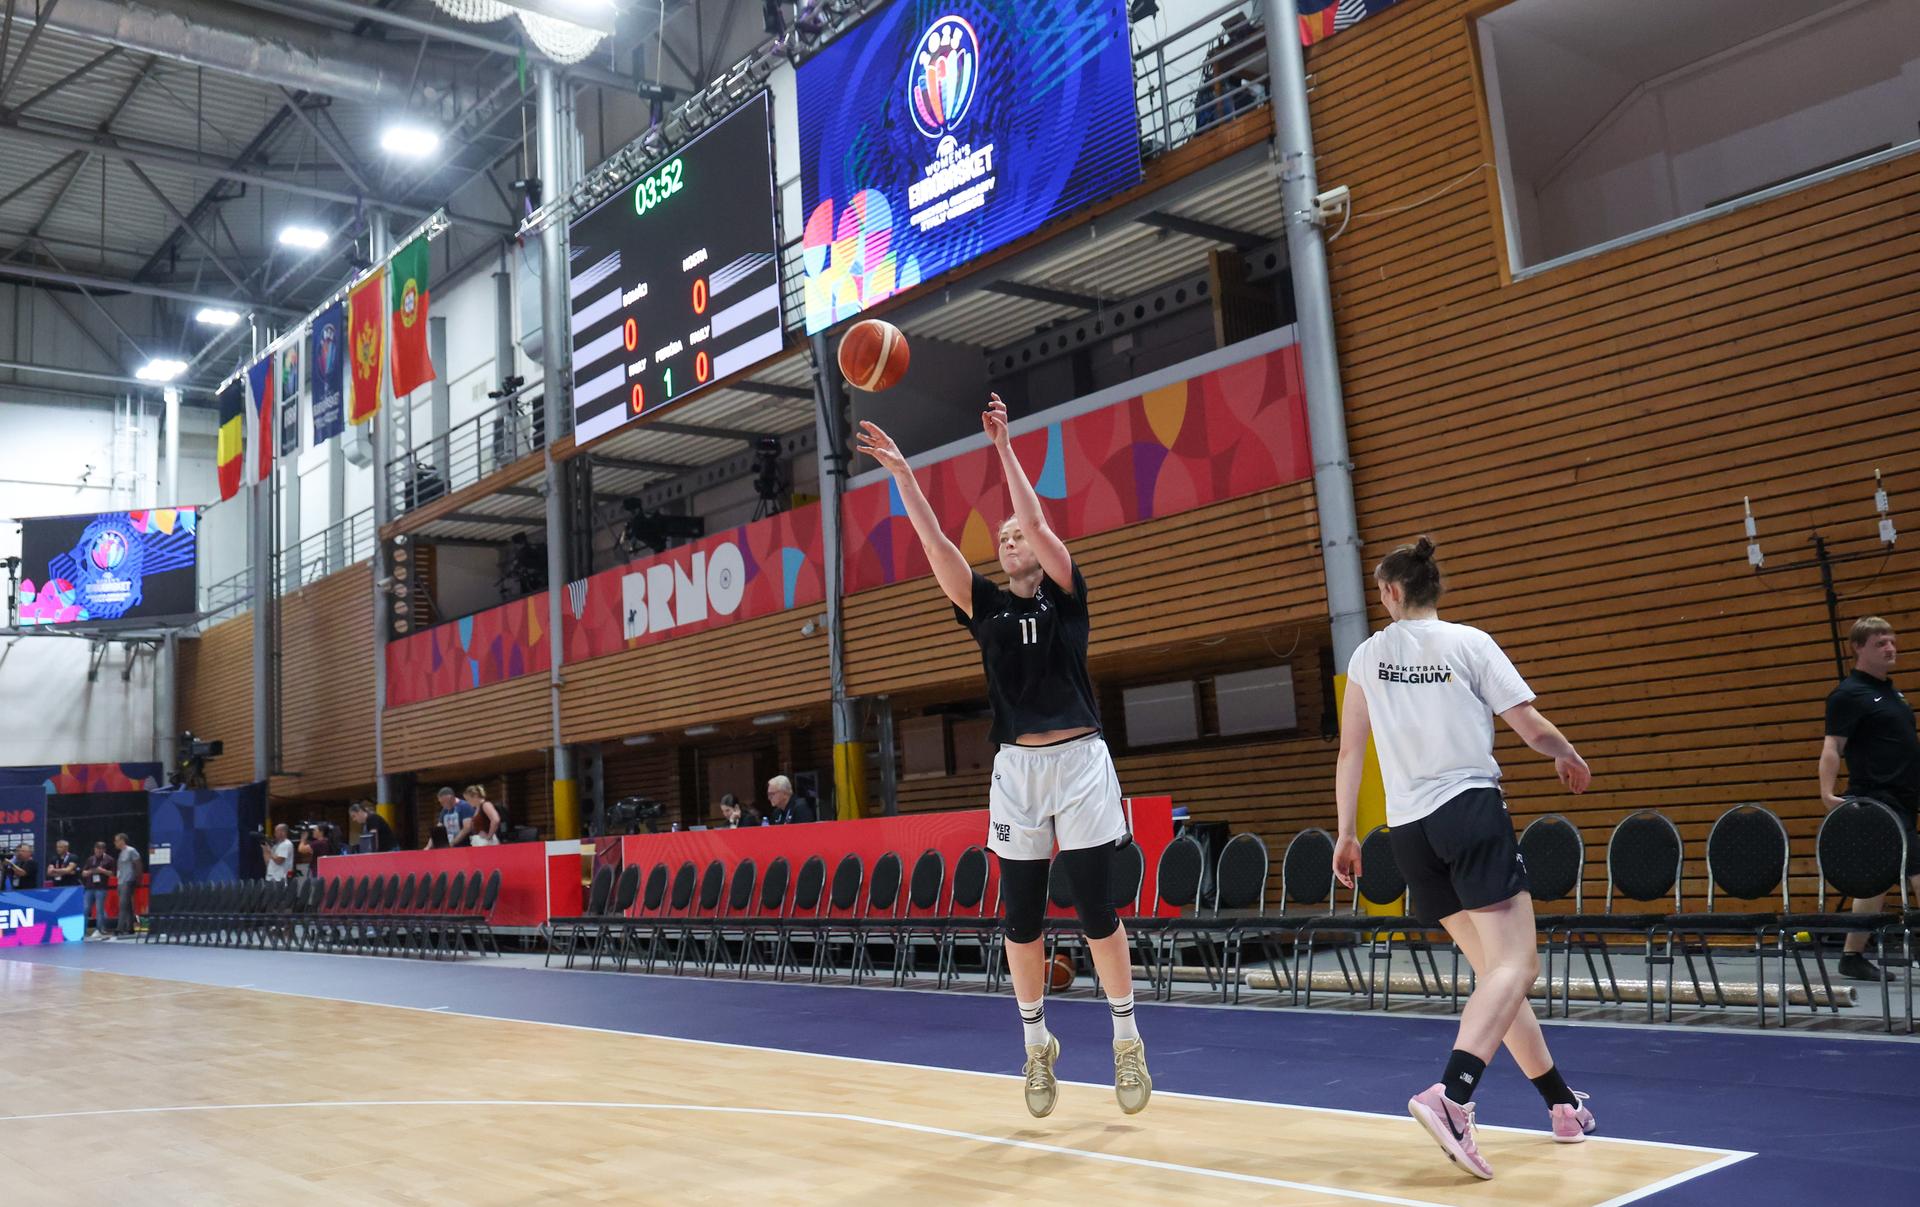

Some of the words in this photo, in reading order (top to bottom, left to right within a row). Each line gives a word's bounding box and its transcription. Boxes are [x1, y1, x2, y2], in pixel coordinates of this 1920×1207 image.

[924, 143, 971, 177] WOMEN'S
[634, 157, 684, 216] 03:52
[692, 278, 707, 315] 0
[624, 317, 638, 352] 0
[663, 367, 672, 398] 1
[695, 351, 708, 383] 0
[632, 383, 644, 414] 0
[621, 541, 746, 641] BRNO
[1019, 618, 1037, 645] 11
[1378, 669, 1452, 684] BELGIUM
[1379, 661, 1452, 672] BASKETBALL
